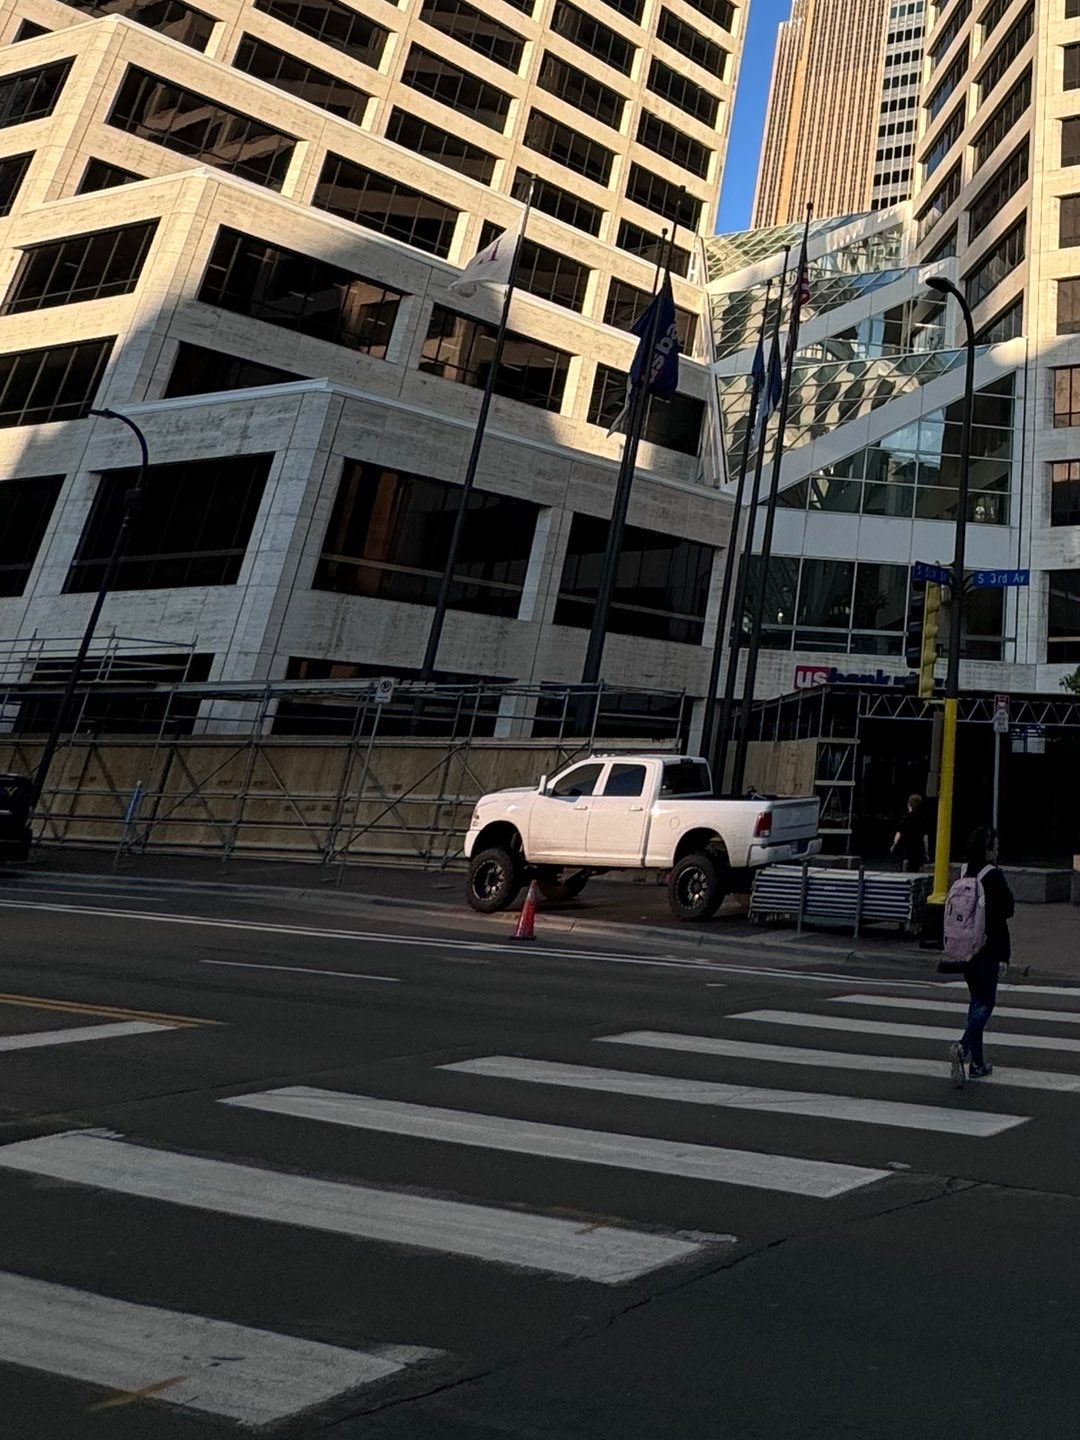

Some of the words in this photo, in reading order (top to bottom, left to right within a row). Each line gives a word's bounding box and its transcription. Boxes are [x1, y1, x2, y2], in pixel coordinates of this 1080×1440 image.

[978, 573, 984, 584] S
[990, 572, 1008, 584] 3rd
[1013, 572, 1026, 583] Av
